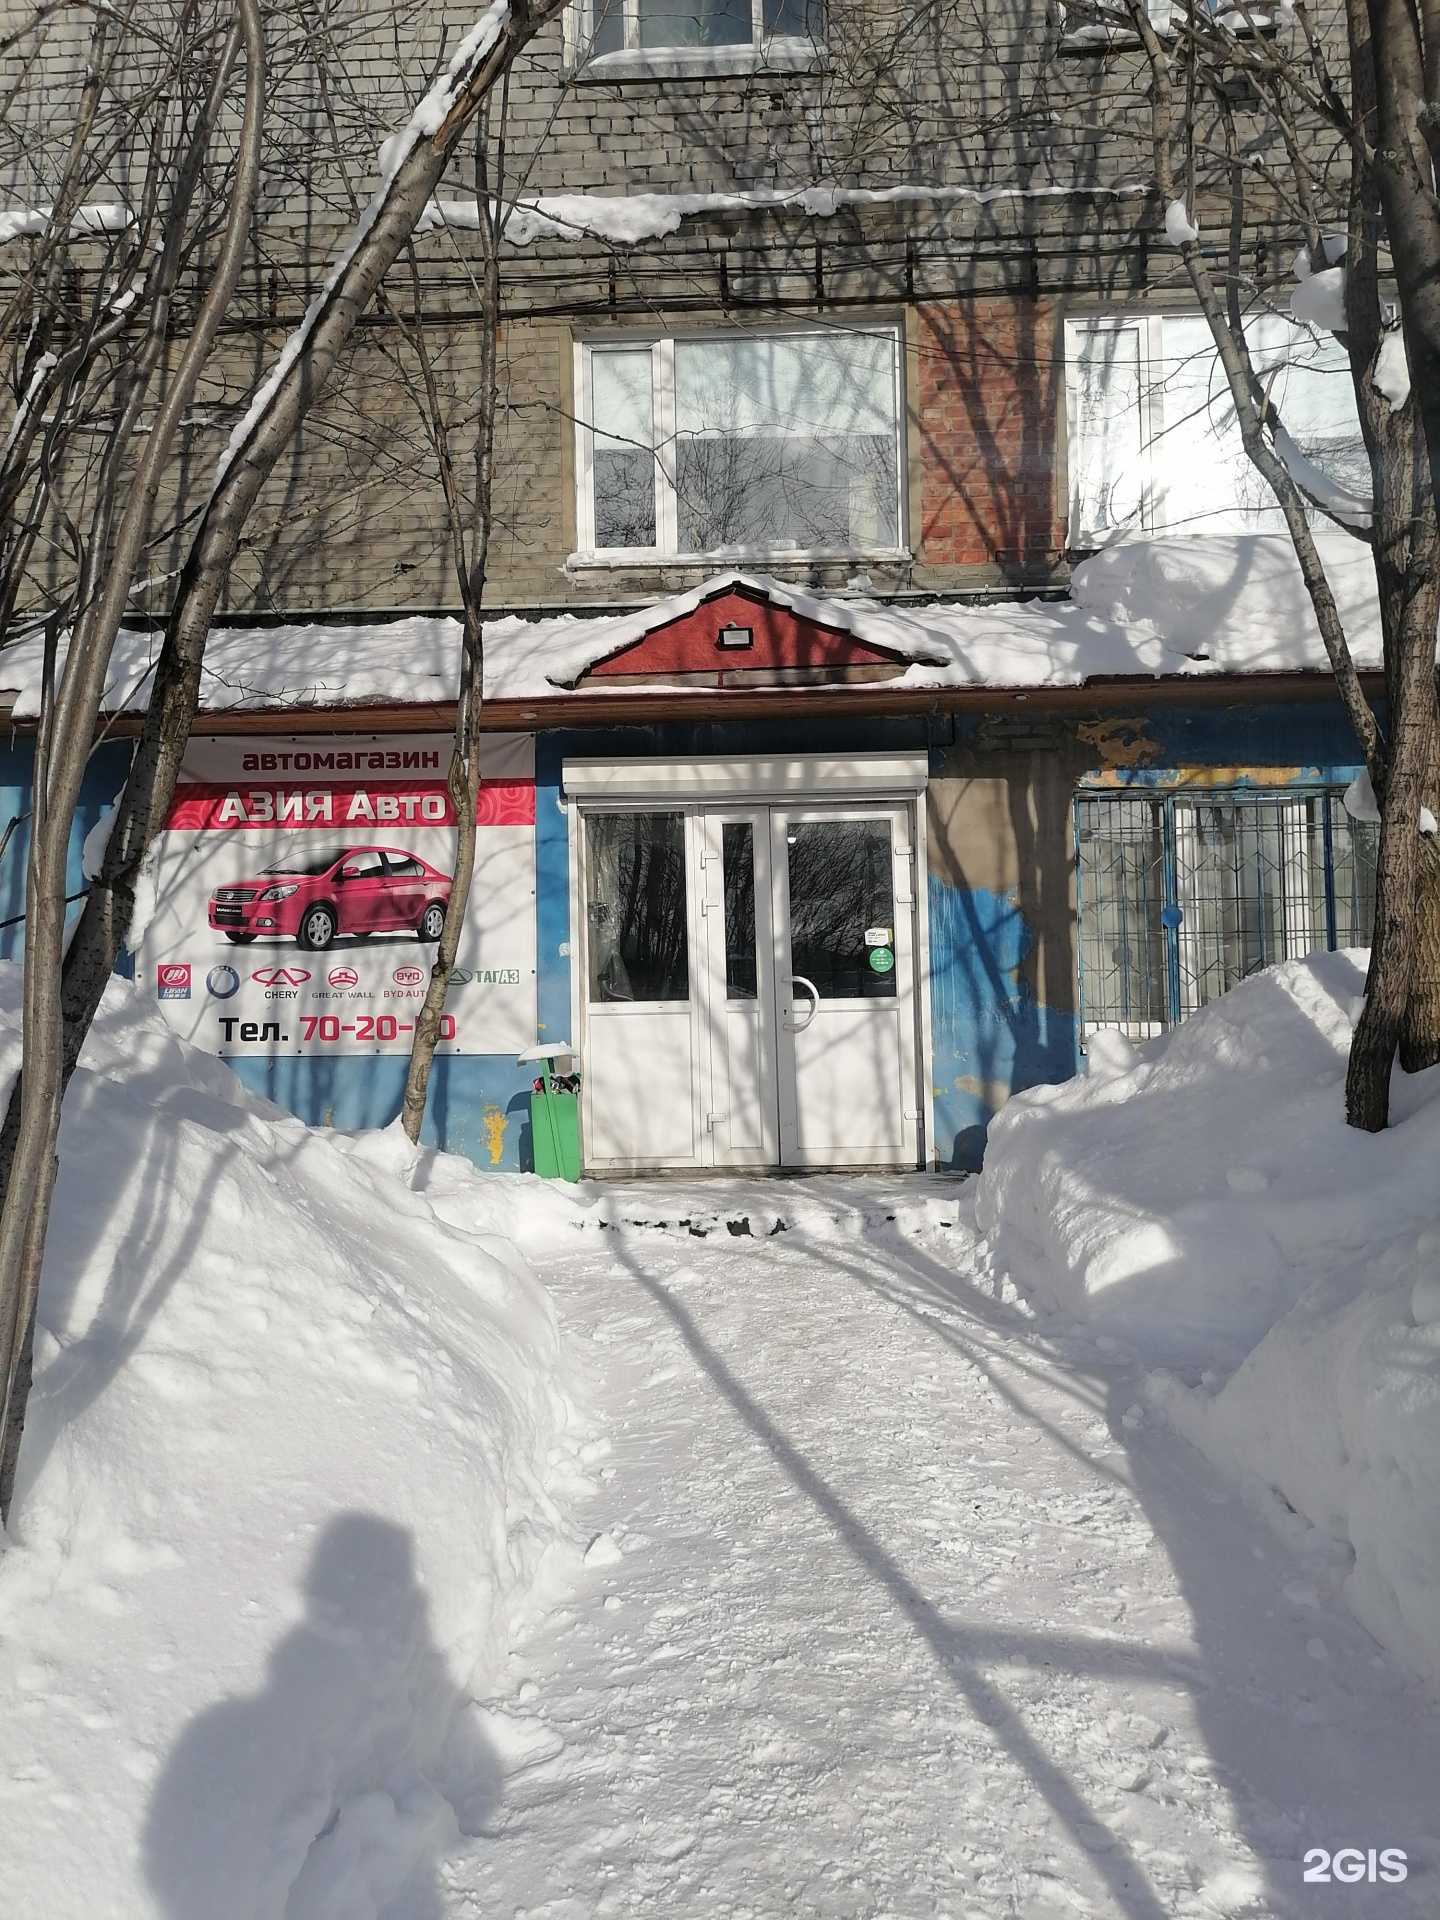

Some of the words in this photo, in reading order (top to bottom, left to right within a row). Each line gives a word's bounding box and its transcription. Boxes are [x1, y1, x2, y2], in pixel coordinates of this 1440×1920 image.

[242, 751, 439, 771] автомагазин
[219, 791, 333, 822] АЗИЯ
[346, 789, 446, 820] Авто
[264, 990, 298, 999] CHERY
[311, 991, 344, 999] GREAT
[347, 991, 375, 999] WALL
[383, 990, 404, 998] BYD
[405, 990, 427, 998] AUT
[218, 1017, 289, 1042] Тел.
[300, 1014, 456, 1042] 70-20-0
